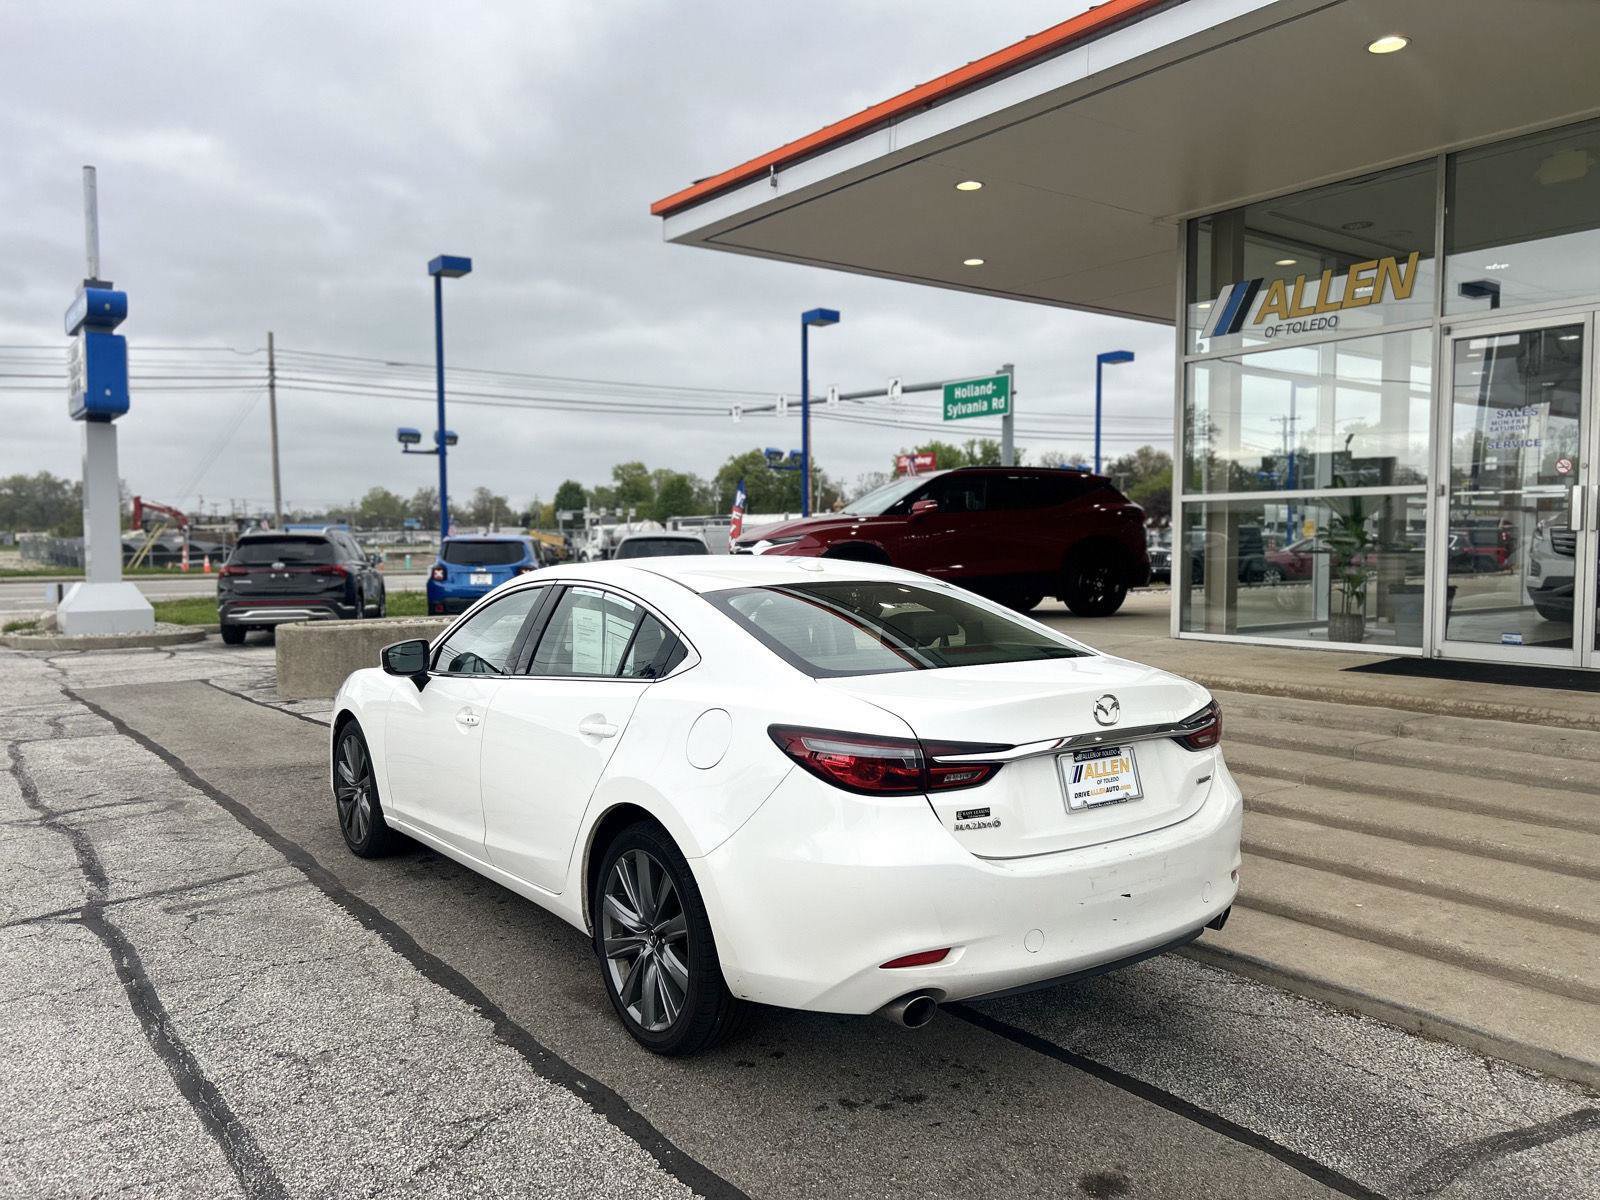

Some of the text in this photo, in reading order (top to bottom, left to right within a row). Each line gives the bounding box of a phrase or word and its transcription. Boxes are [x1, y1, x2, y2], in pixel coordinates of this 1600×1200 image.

[1253, 251, 1420, 325] ALLEN
[1264, 315, 1339, 338] OF TOLEDO
[954, 381, 997, 399] Holland-
[946, 396, 1005, 418] Sylvania Rd
[1496, 407, 1538, 419] SALES
[1488, 439, 1542, 449] SERVICE
[1084, 757, 1130, 779] ALLEN
